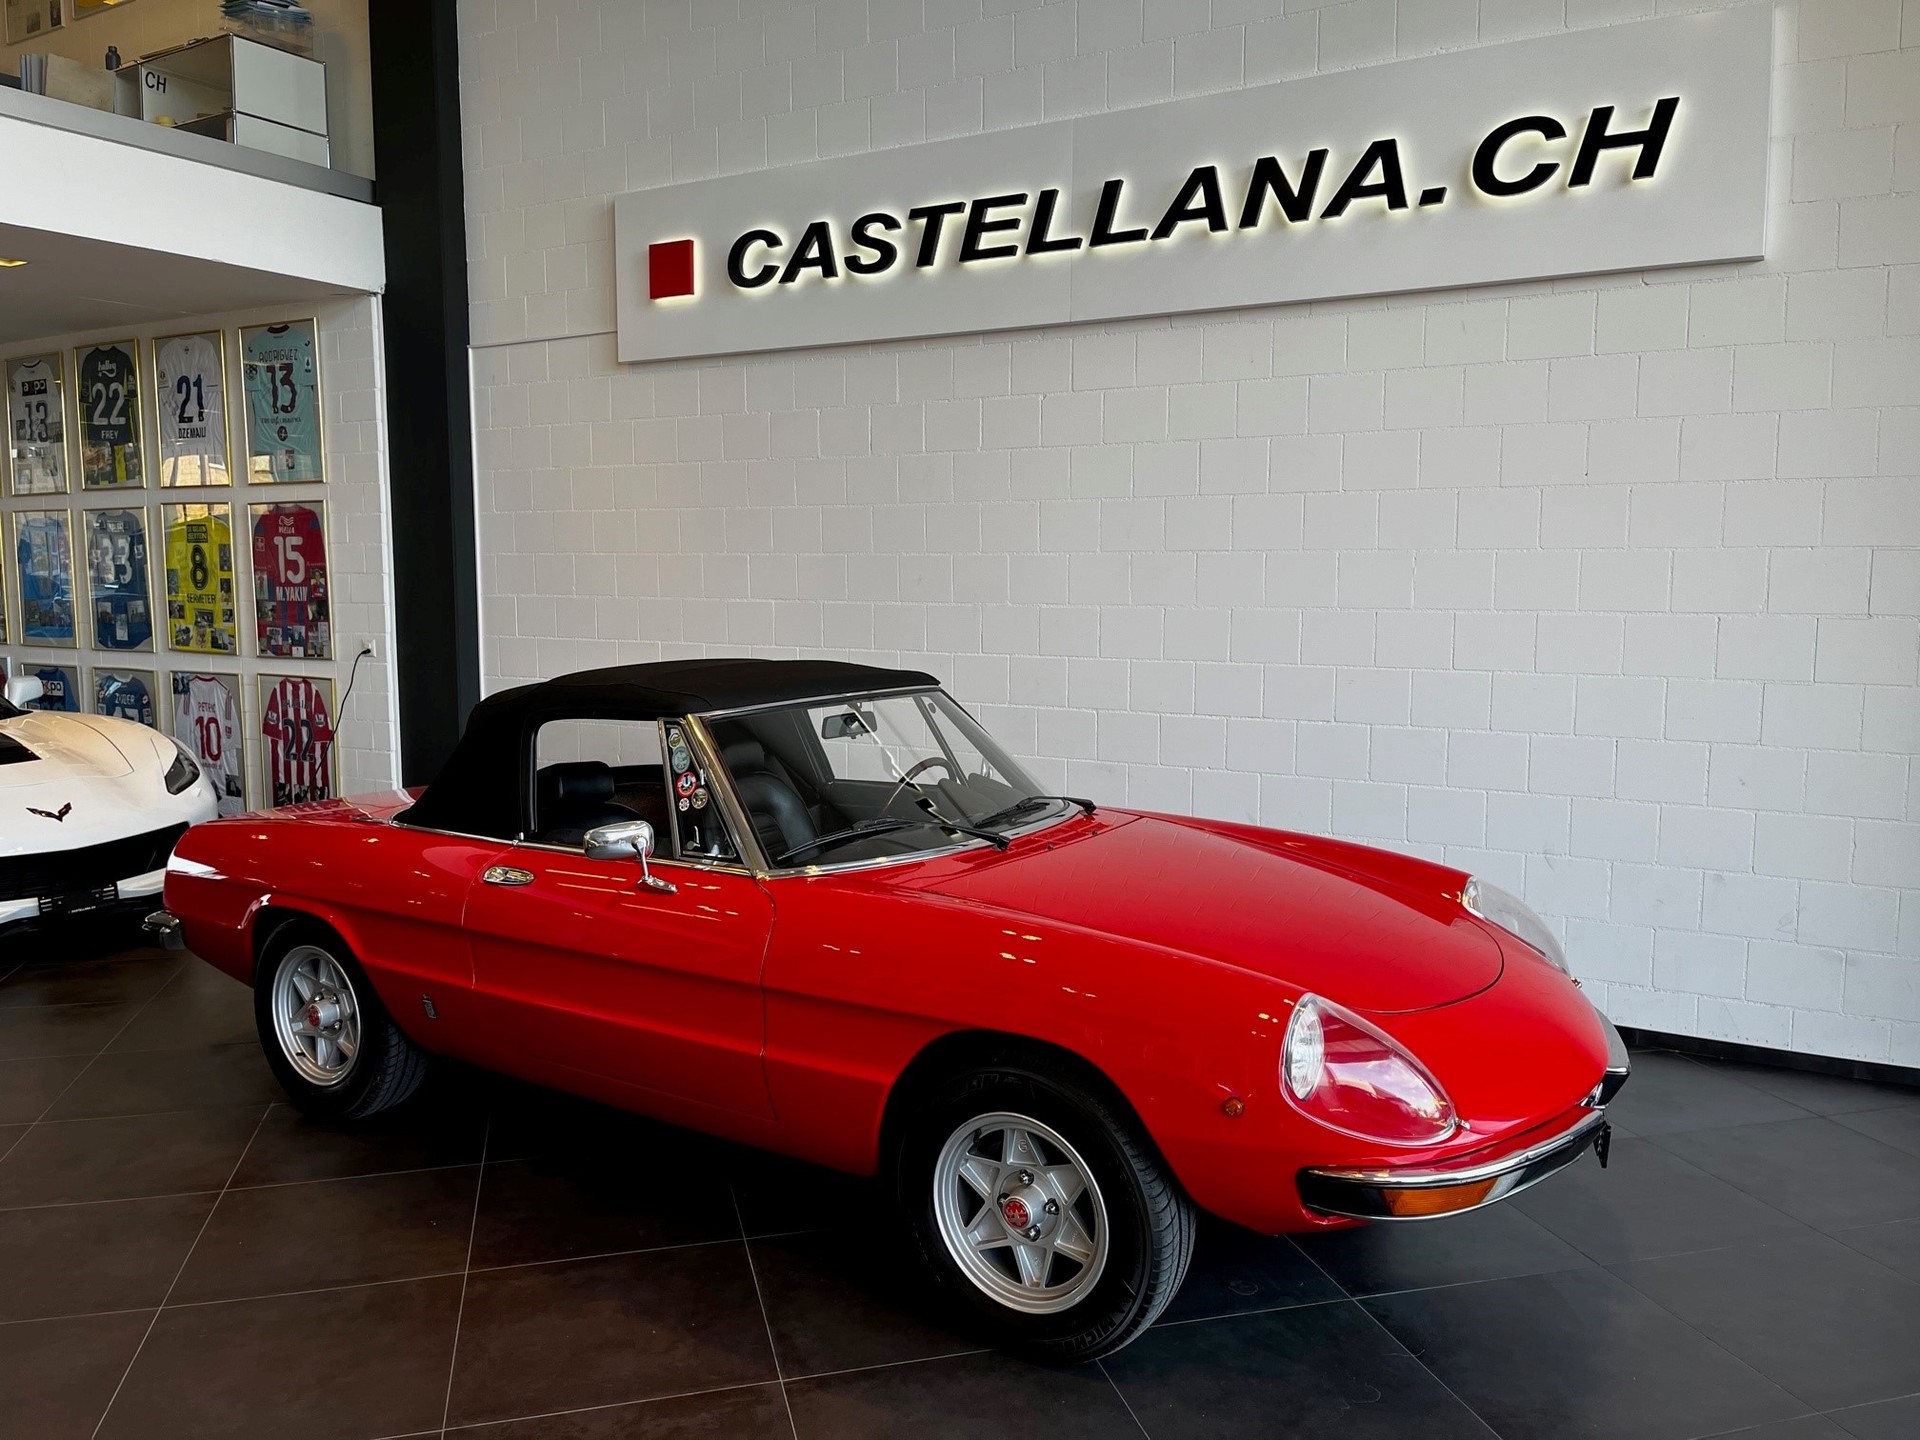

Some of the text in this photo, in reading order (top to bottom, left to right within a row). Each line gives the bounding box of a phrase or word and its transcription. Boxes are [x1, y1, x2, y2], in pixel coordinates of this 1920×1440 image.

[145, 71, 167, 94] CH
[727, 96, 1681, 289] CASTELLANA.CH
[92, 382, 126, 425] 22
[176, 373, 205, 424] 21
[266, 362, 298, 414] 13
[190, 544, 210, 591] 8
[273, 536, 306, 584] 15
[194, 715, 222, 762] 10
[282, 717, 315, 762] 22
